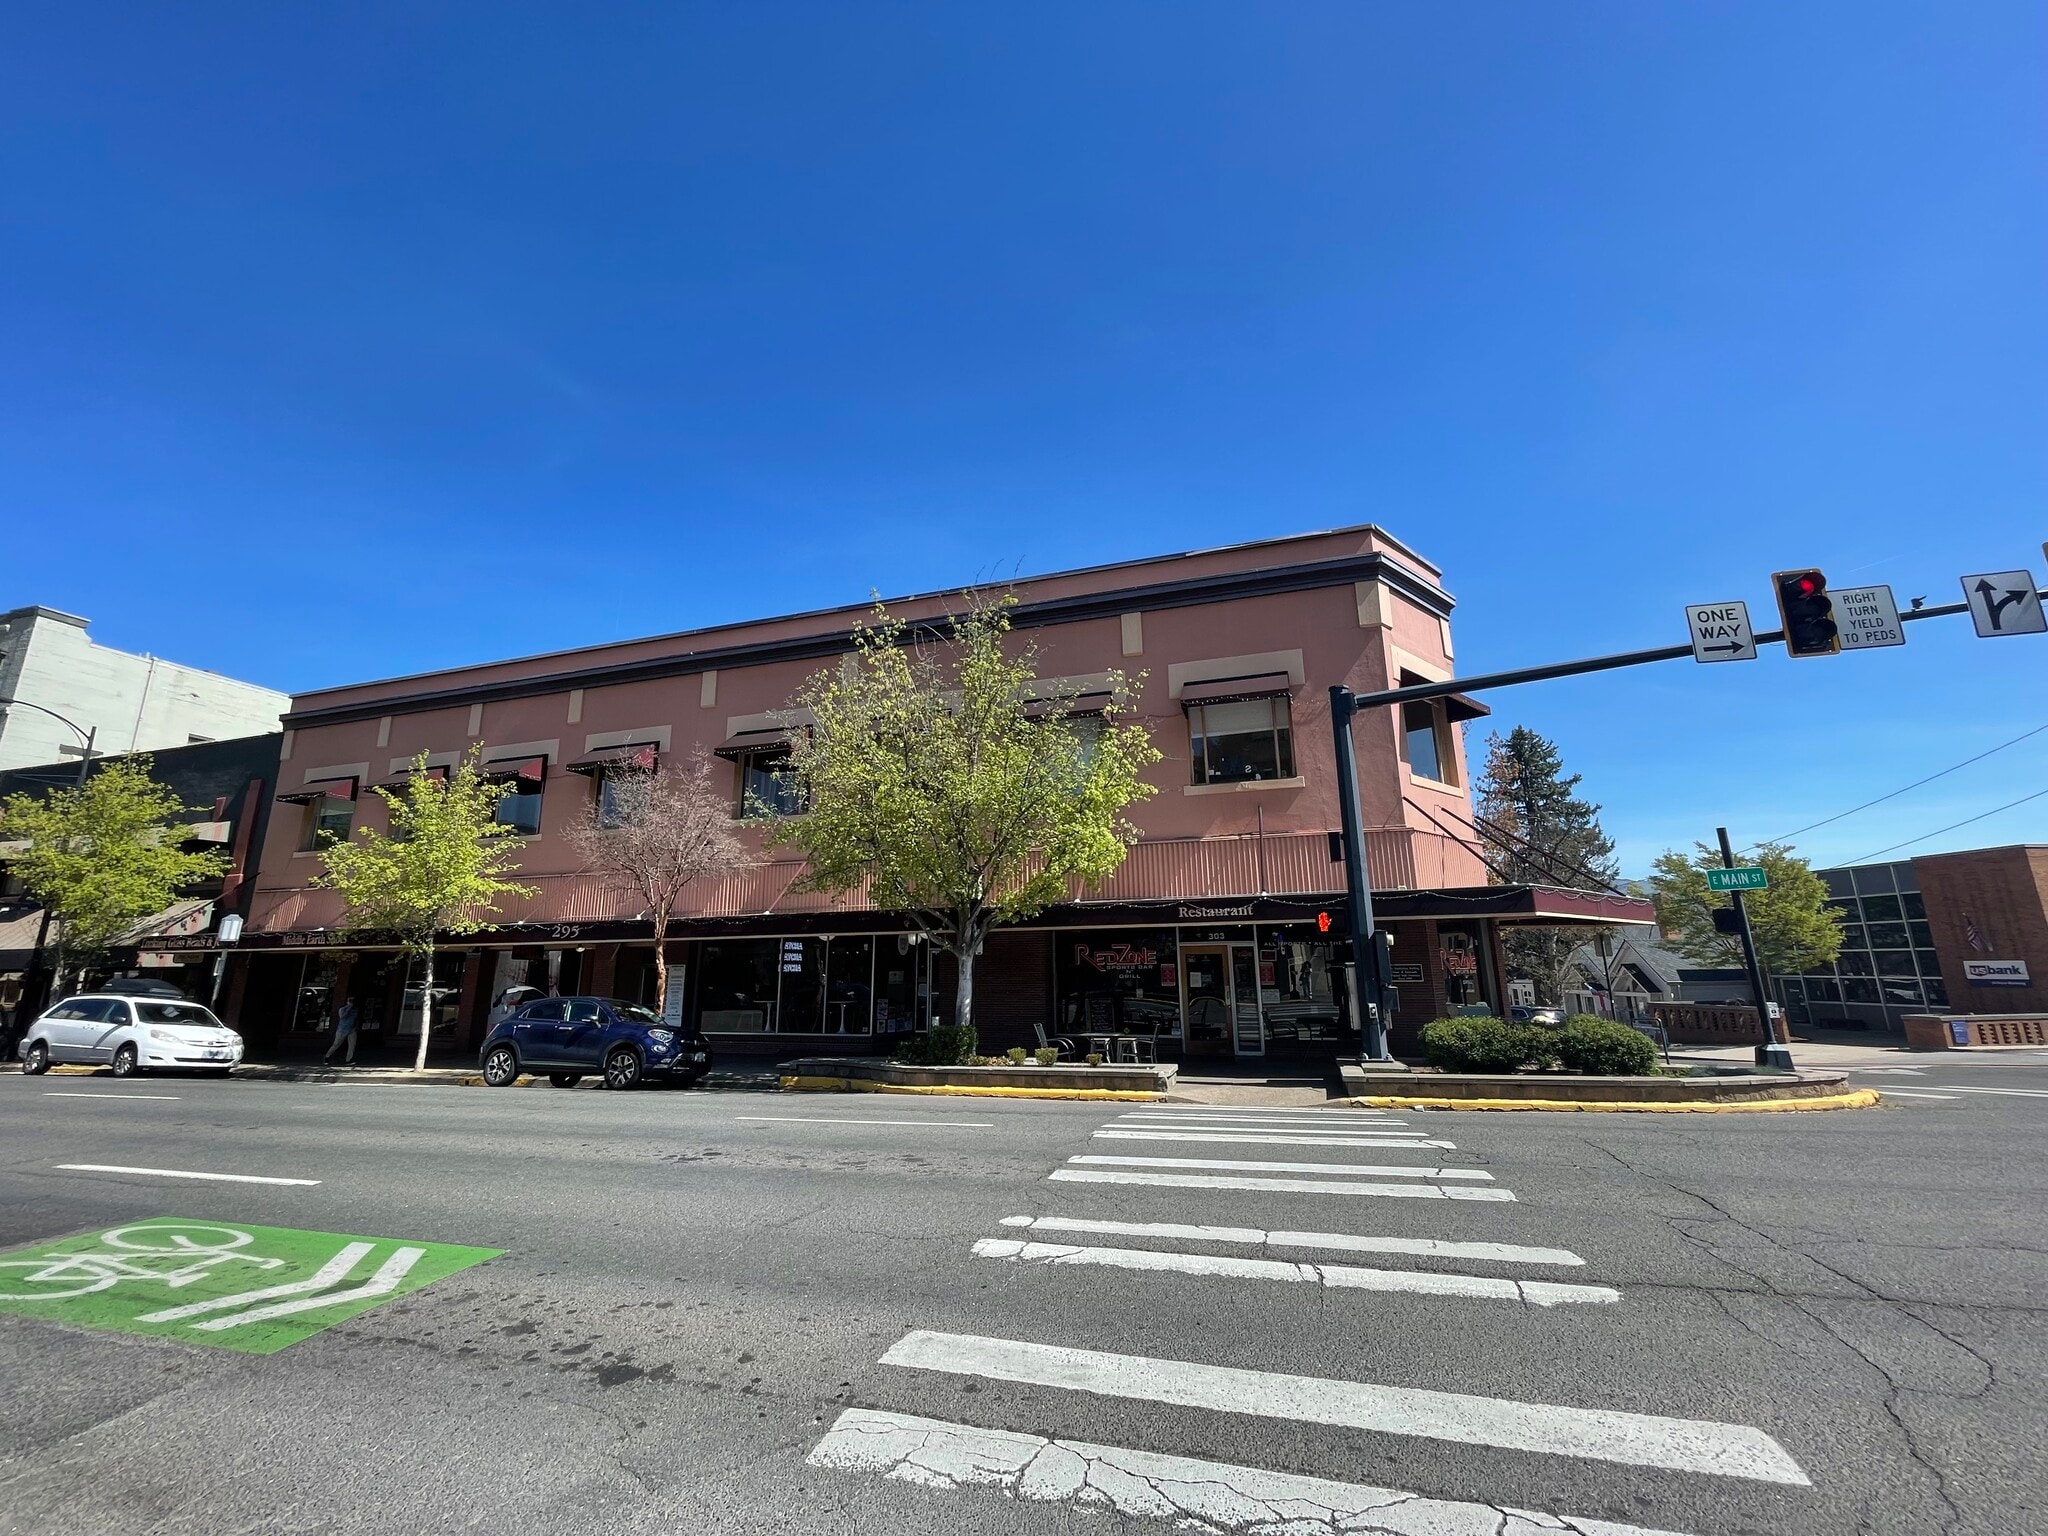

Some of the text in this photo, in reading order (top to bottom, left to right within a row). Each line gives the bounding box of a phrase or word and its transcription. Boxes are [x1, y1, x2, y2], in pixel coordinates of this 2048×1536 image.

[1842, 592, 1876, 605] RIGHT
[1697, 608, 1739, 623] ONE
[1847, 605, 1879, 617] TURN
[1849, 617, 1884, 629] YIELD
[1698, 623, 1741, 640] WAY
[1843, 629, 1897, 643] TO PEDS
[1712, 872, 1761, 886] E MAIN ST
[1178, 905, 1254, 918] Restaurant
[551, 924, 580, 939] 295
[1208, 932, 1225, 940] 303
[306, 933, 326, 945] Earth
